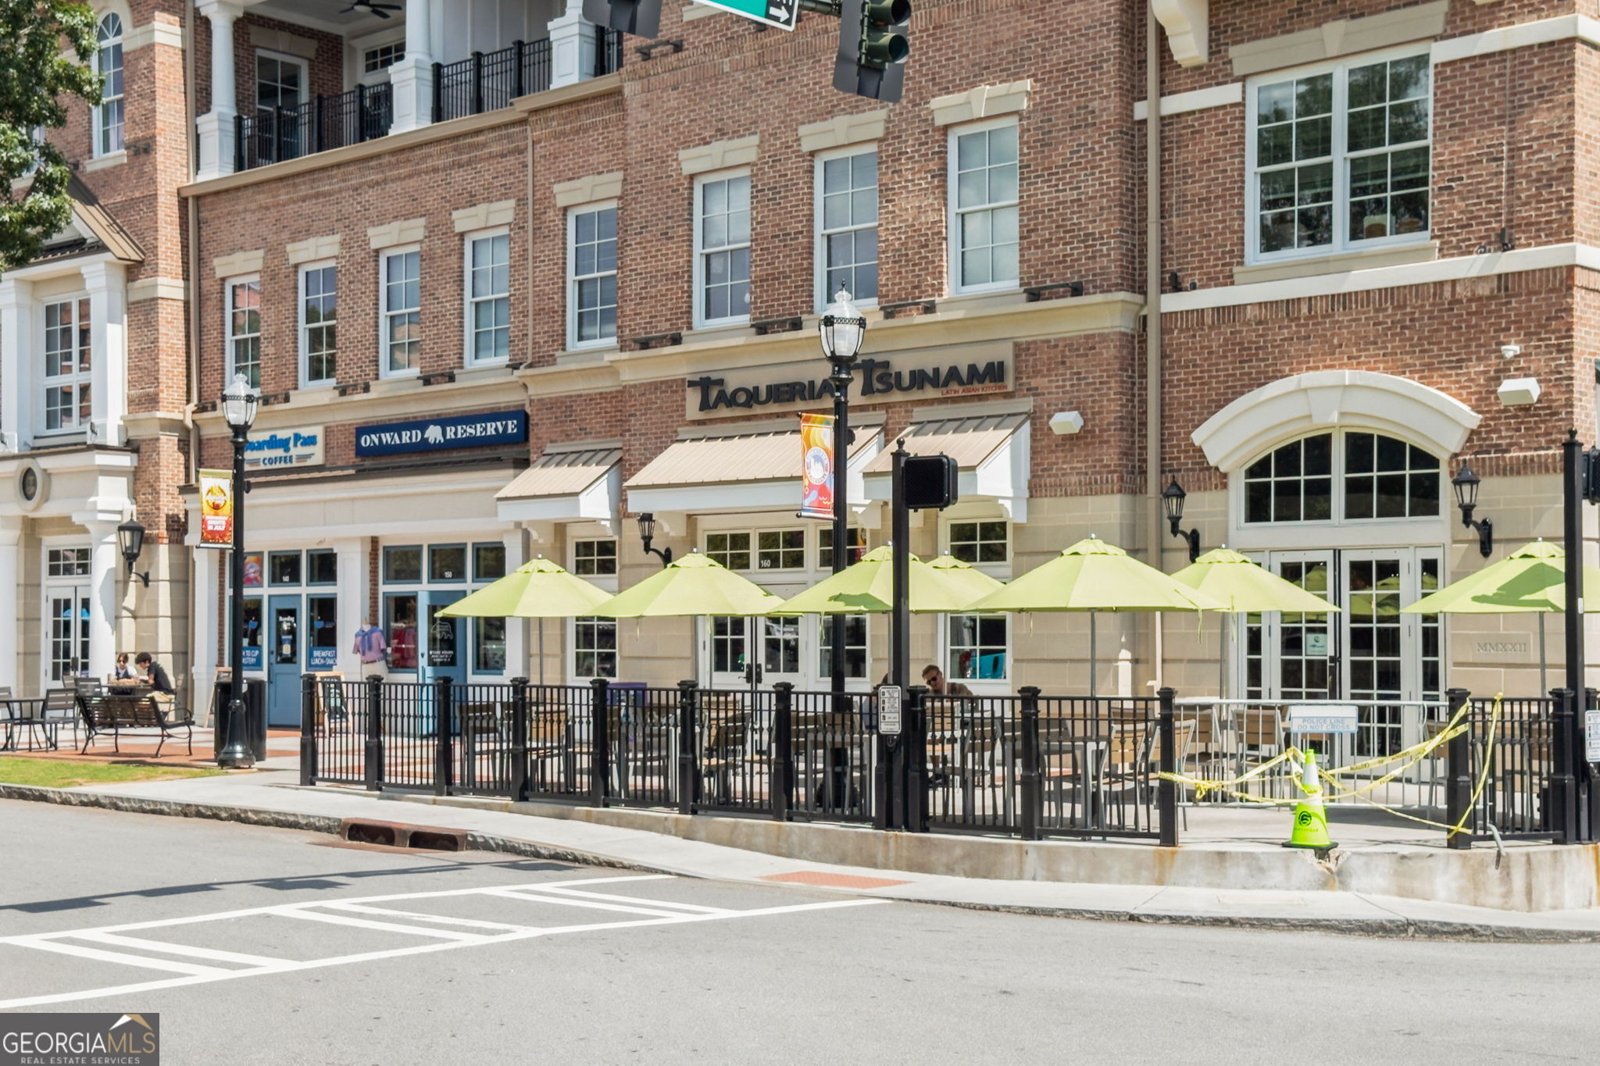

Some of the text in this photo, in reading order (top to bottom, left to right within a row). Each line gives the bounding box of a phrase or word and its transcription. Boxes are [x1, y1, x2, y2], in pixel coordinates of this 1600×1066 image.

[688, 359, 1005, 411] TAQUERIA TSUNAMI
[360, 419, 518, 448] ONWARD RESERVE
[245, 434, 292, 453] oarding
[262, 455, 294, 465] COFFEE
[761, 559, 771, 567] 160
[1476, 642, 1527, 652] MMXXII
